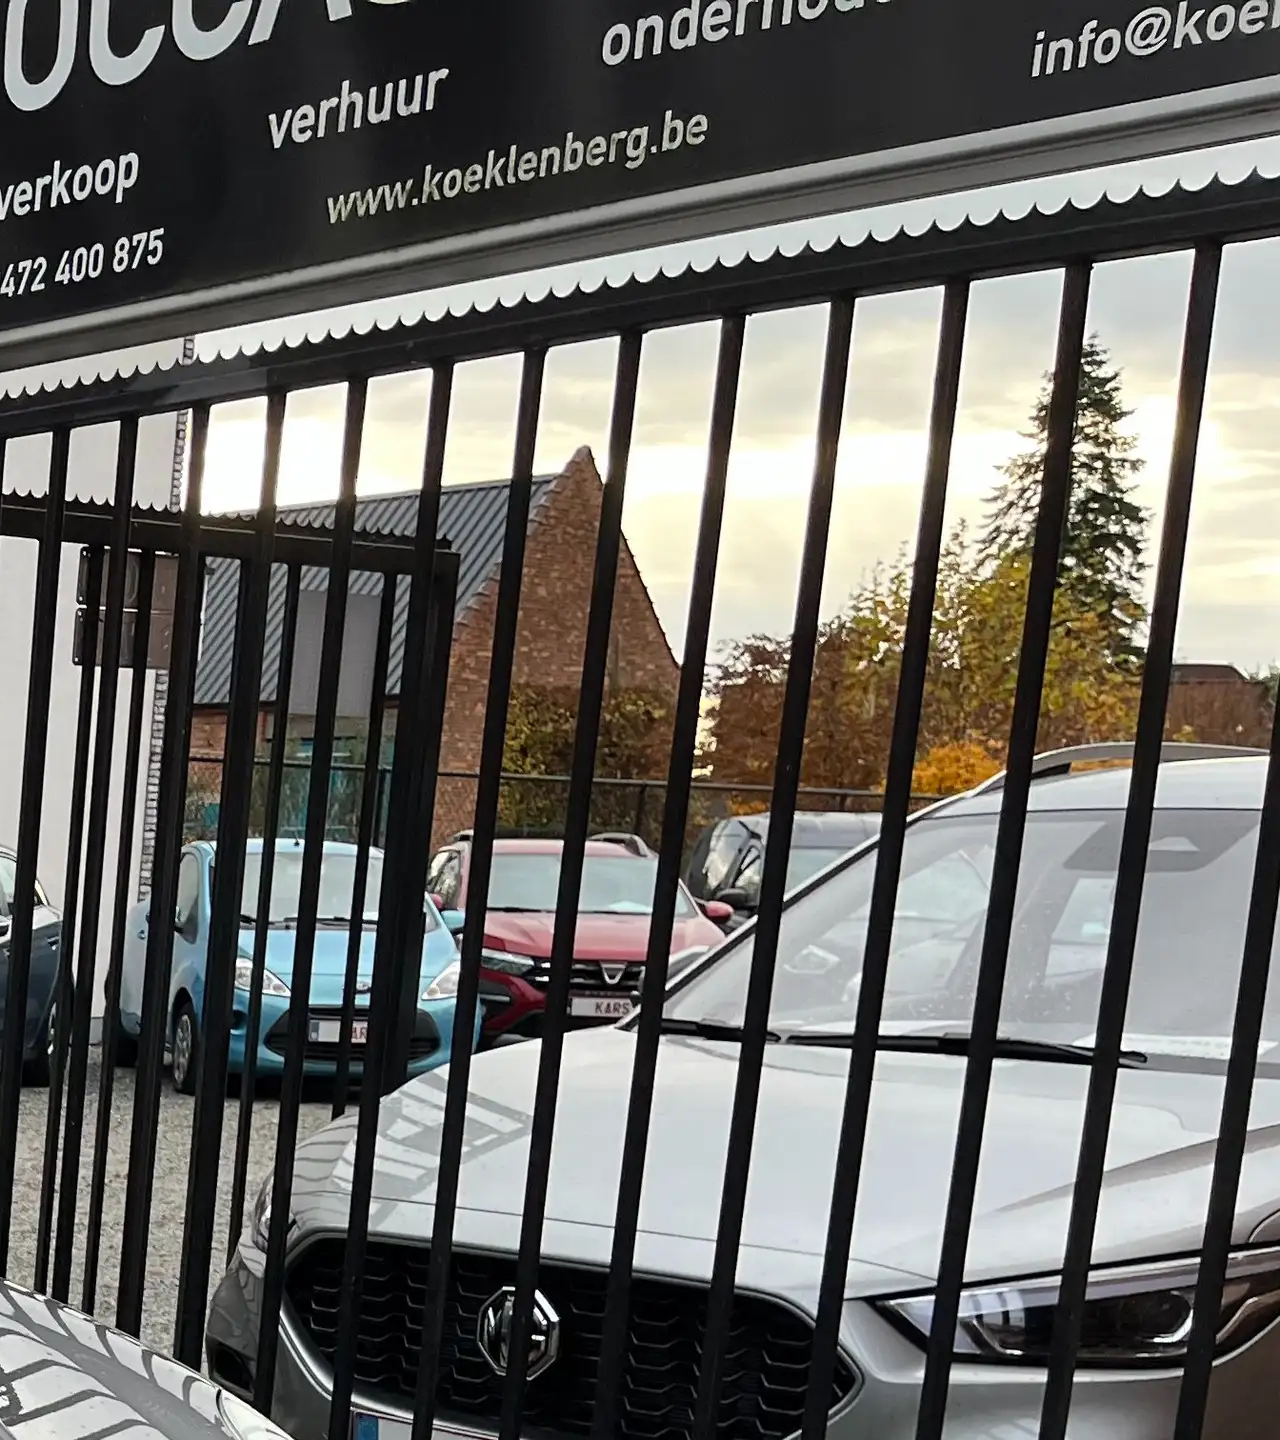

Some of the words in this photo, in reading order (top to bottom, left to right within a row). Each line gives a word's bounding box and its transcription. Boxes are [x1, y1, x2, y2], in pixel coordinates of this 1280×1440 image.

[1031, 0, 1280, 77] info@koe
[267, 67, 449, 149] verhuur
[327, 109, 709, 224] www.koeklenberg.be
[55, 242, 104, 289] 400
[113, 228, 165, 274] 875
[595, 1002, 631, 1015] KARS
